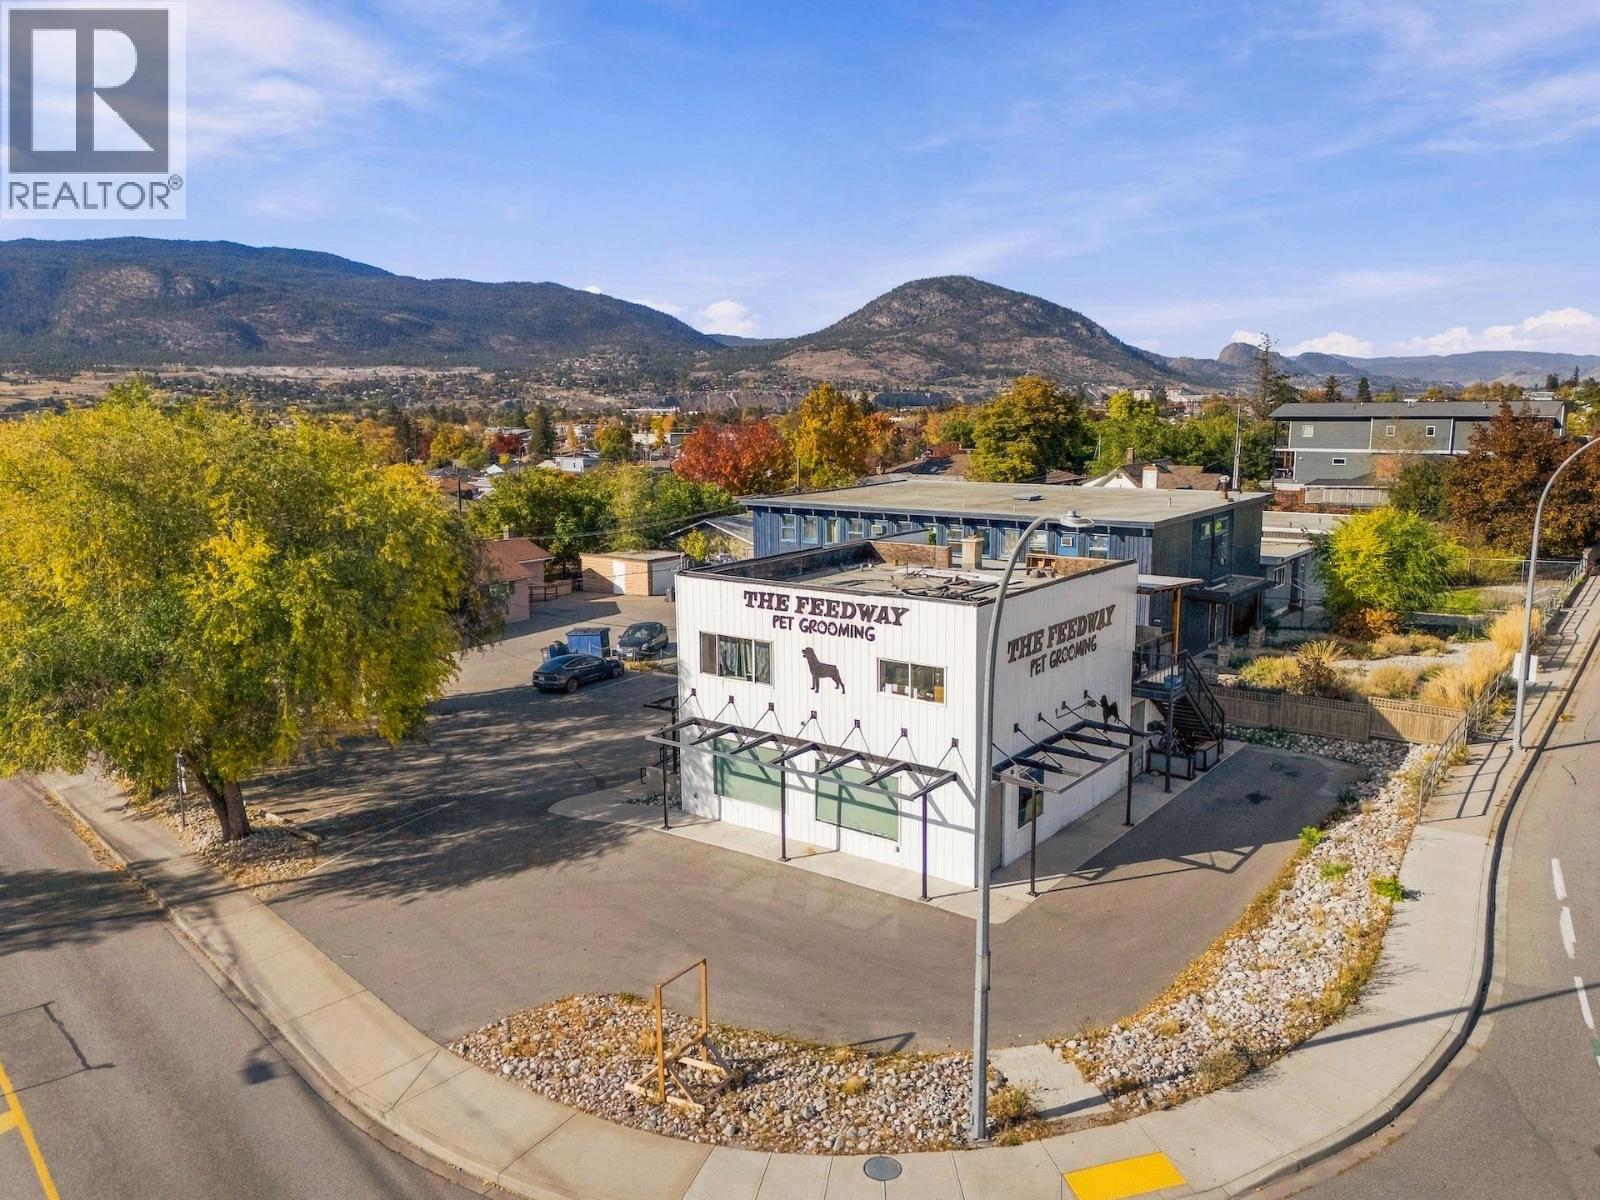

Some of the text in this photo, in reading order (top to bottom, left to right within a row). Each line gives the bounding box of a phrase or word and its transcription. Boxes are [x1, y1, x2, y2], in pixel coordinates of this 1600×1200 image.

[744, 590, 910, 627] THE FEEDWAY
[772, 615, 876, 642] PET GROOMING
[1007, 604, 1116, 664] THE FEEDWAY
[1030, 634, 1097, 678] PET GROOMING
